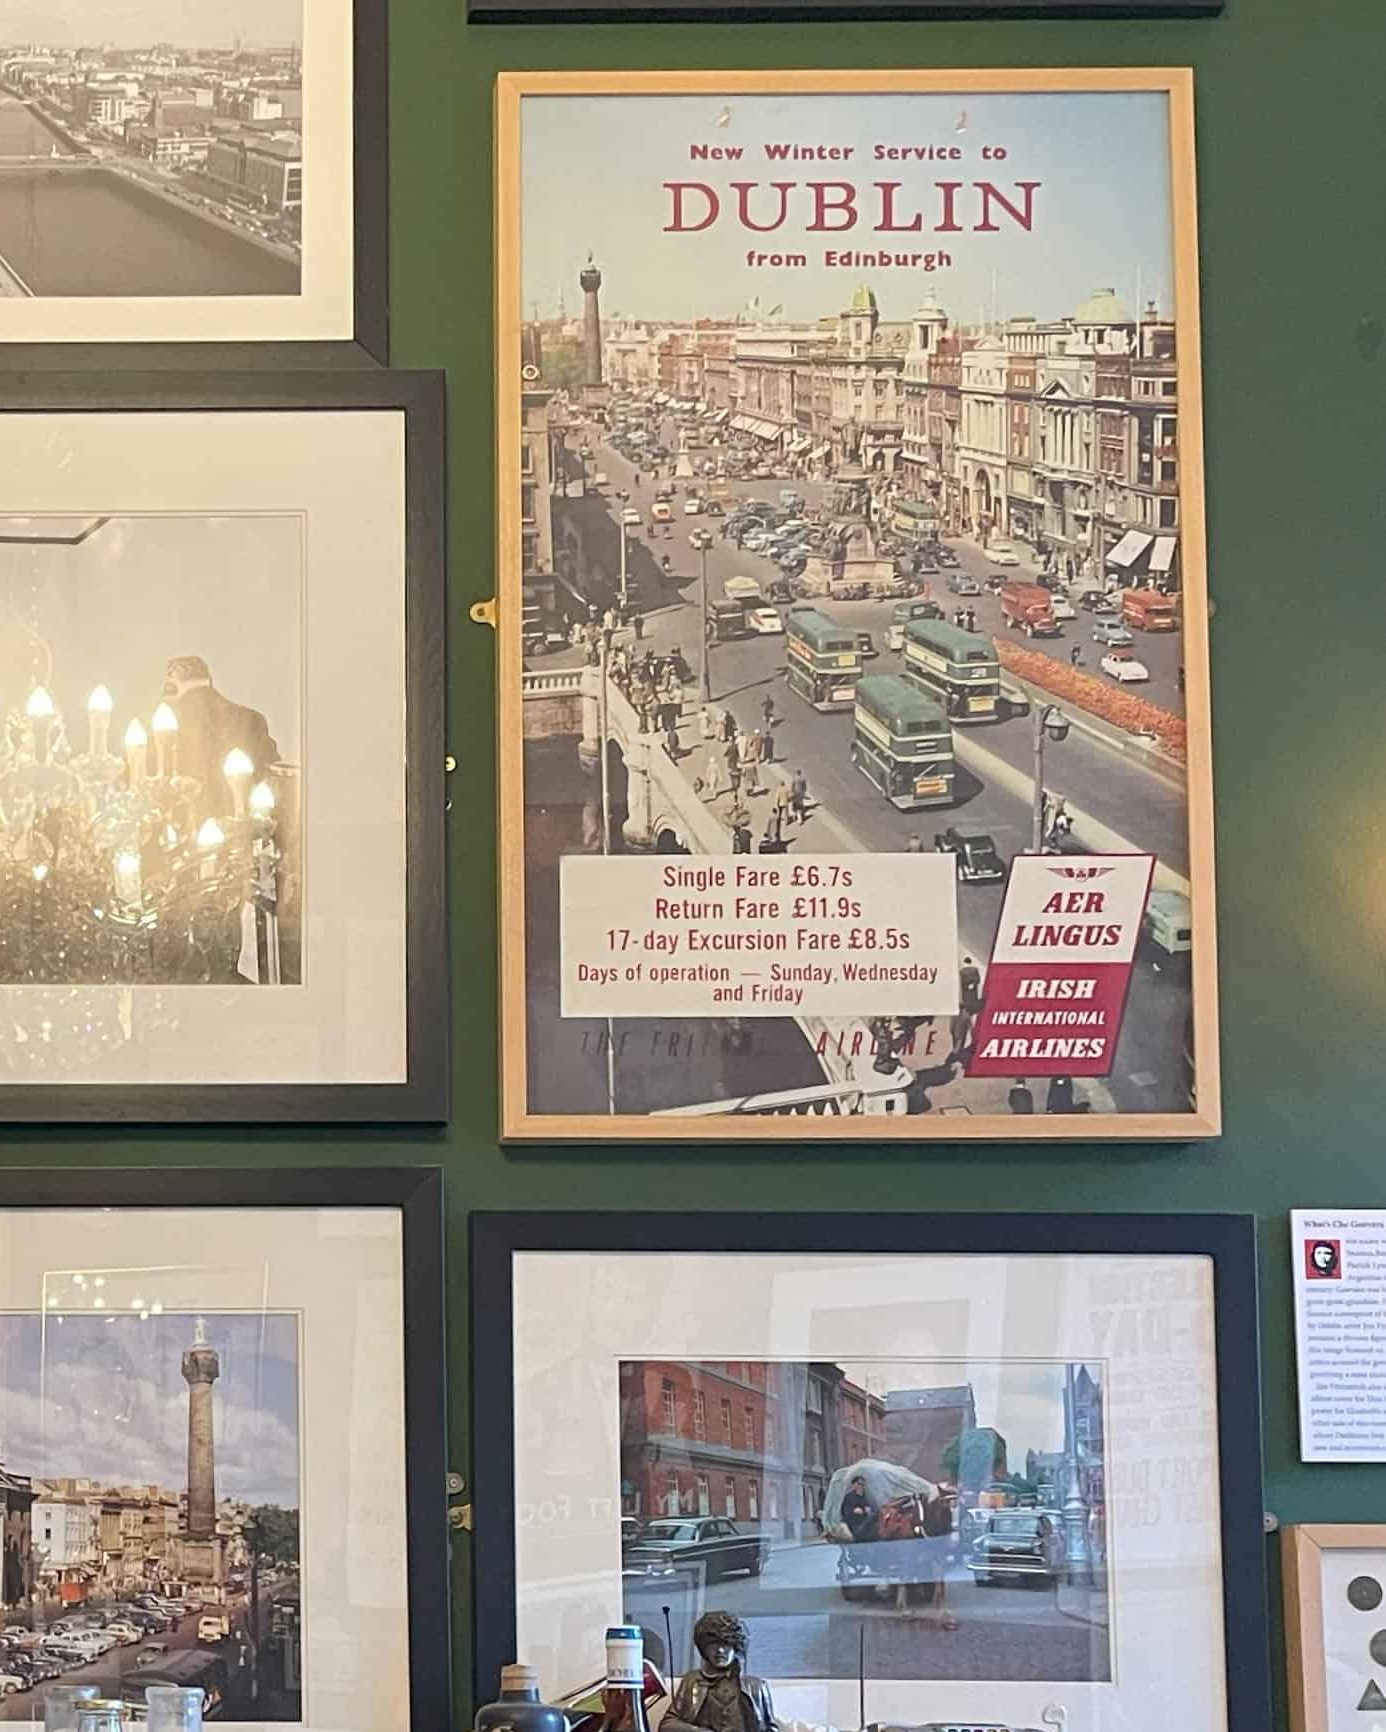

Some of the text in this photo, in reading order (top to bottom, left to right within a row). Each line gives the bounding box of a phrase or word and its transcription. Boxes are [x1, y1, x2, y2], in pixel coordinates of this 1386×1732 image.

[690, 144, 1008, 161] New Winter Service to
[662, 181, 1041, 234] DUBLIN
[746, 249, 952, 271] from Edinburgh
[663, 865, 853, 891] Single Fare £6.7s
[655, 898, 862, 920] Return Fare £11.9s
[1041, 892, 1105, 914] AER
[606, 929, 910, 956] 17-day Excursion Fare £8.5s
[1011, 924, 1122, 947] LINGUS
[578, 963, 621, 987] Days
[625, 963, 643, 983] of
[649, 963, 731, 987] operation
[770, 962, 839, 987] Sunday,
[843, 962, 938, 987] Wednesday
[713, 983, 804, 1005] and Friday
[1016, 979, 1096, 999] IRISH
[991, 1011, 1106, 1026] INTERNATIONAL
[817, 1031, 936, 1057] AIRLNE
[980, 1037, 1106, 1060] AIRLINES
